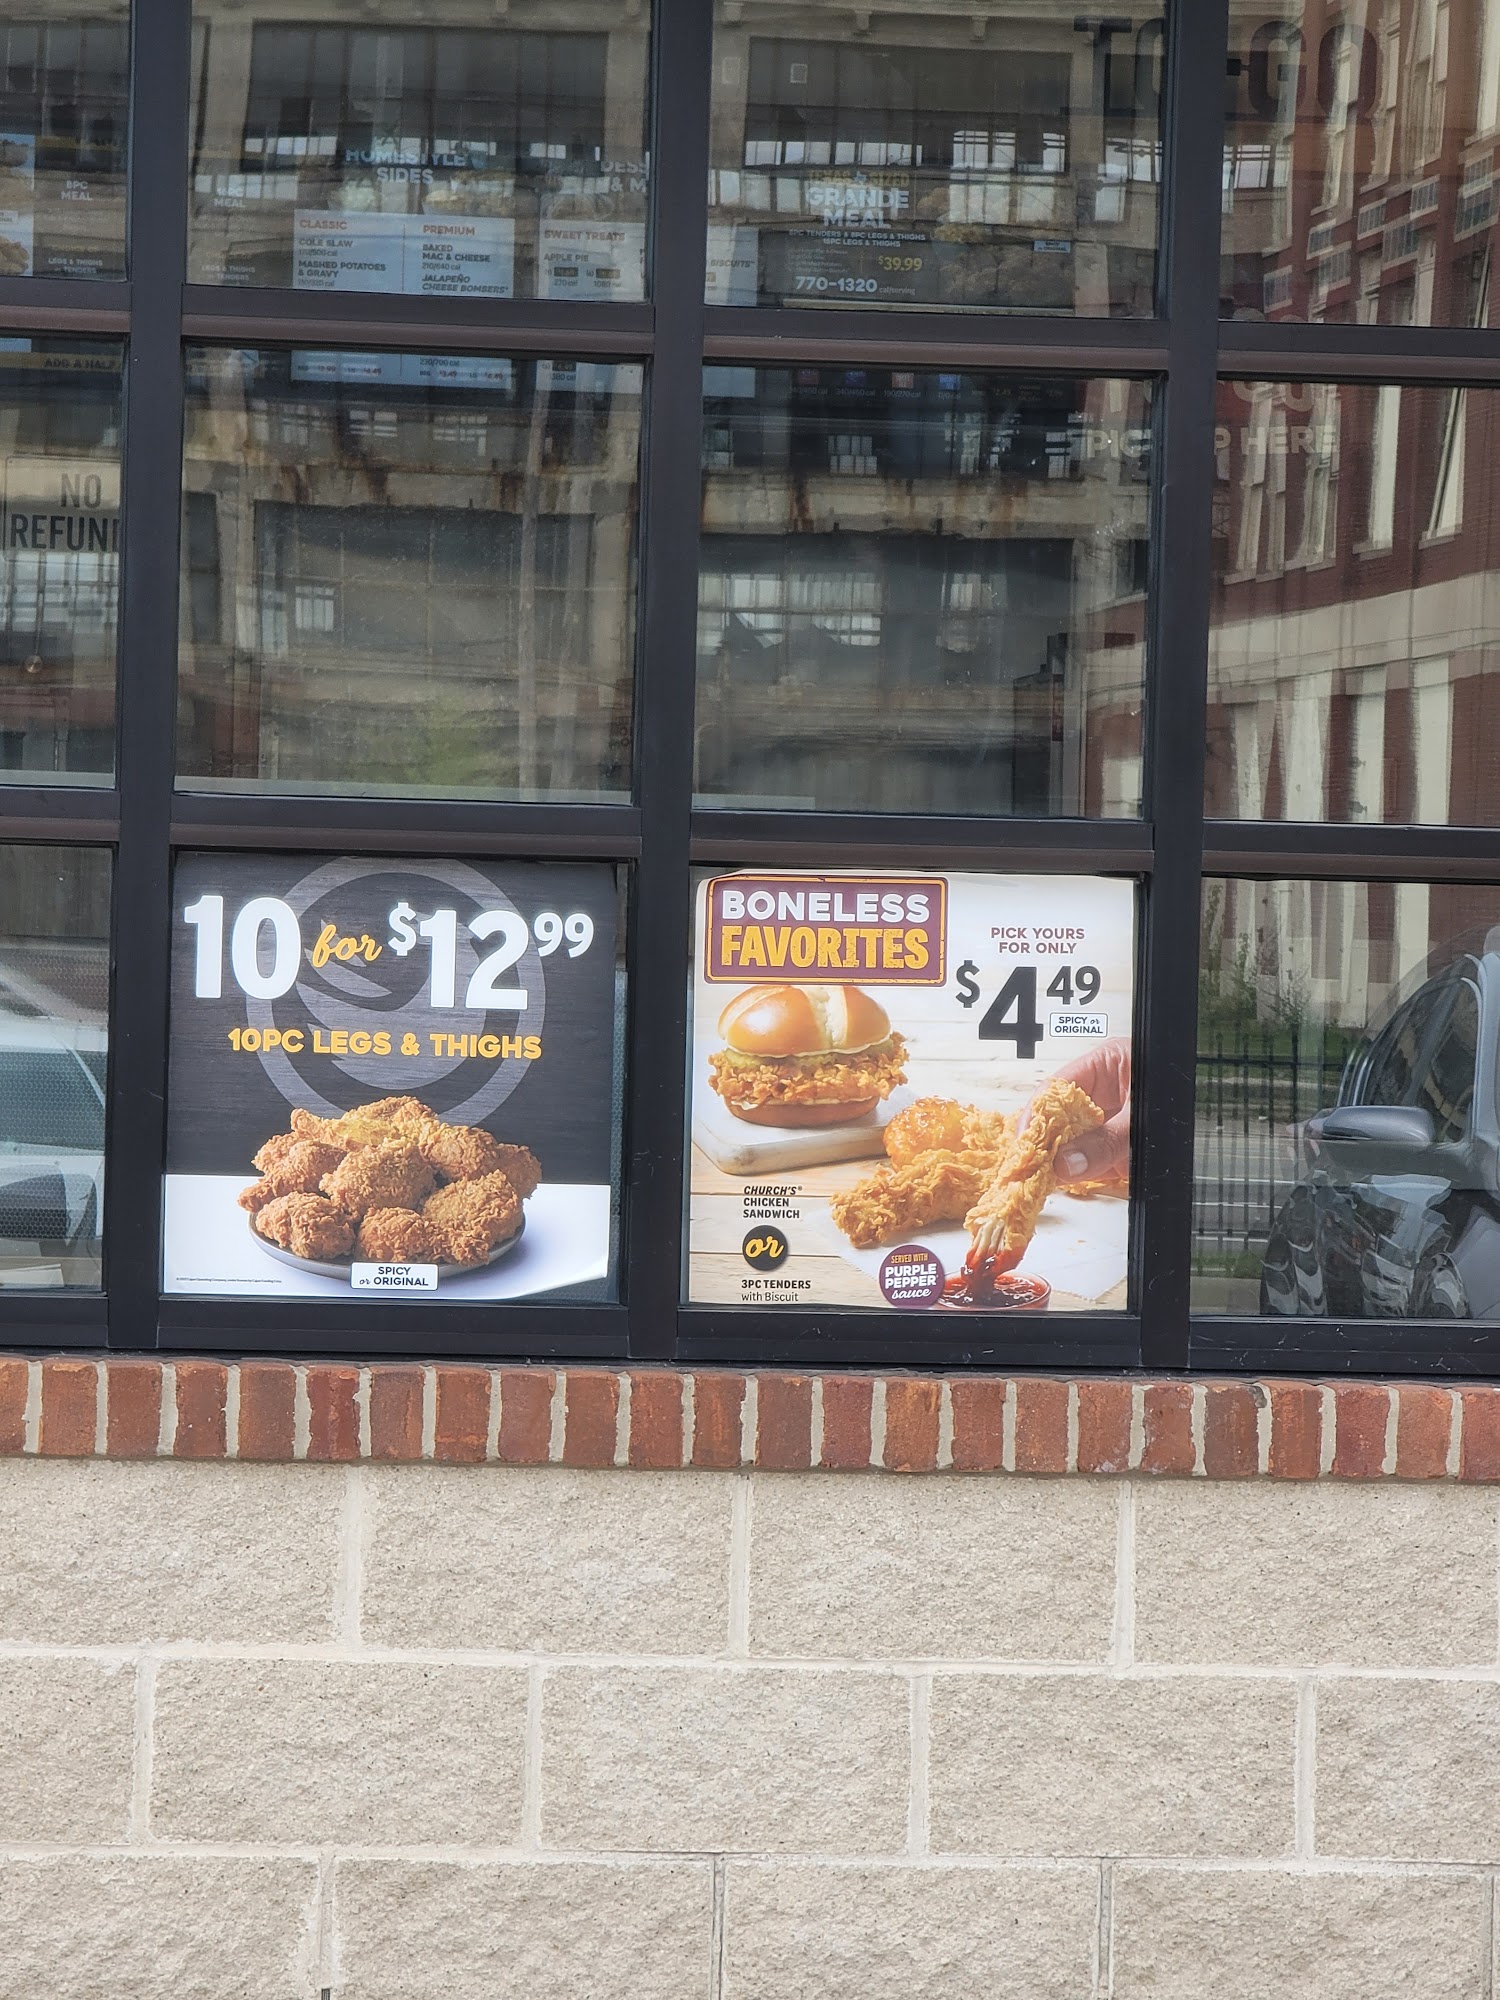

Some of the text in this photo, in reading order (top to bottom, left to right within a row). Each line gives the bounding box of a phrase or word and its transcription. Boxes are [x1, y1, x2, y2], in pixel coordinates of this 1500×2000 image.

[376, 167, 434, 185] SIDES
[61, 191, 93, 201] MEAL
[807, 187, 910, 209] GRANDE
[213, 198, 246, 208] MEAL
[824, 208, 892, 229] MEAL
[299, 219, 348, 231] CLASSIC
[423, 225, 476, 236] PREMIUM
[544, 229, 626, 242] SWEET TREATS
[806, 230, 841, 238] TENDERS
[897, 233, 926, 241] THIGHS
[299, 239, 354, 249] COLE SLAW
[422, 244, 453, 252] BAKED
[872, 240, 901, 248] THIGHS
[422, 253, 443, 261] MAC
[454, 254, 491, 263] CHEESE
[544, 253, 589, 262] APPLE PIE
[879, 255, 923, 272] $39.99
[298, 260, 386, 272] MASHED POTATOES
[307, 270, 339, 278] GRAVY
[422, 273, 471, 284] JALAPEÑO
[422, 283, 458, 292] CHEESE
[795, 276, 878, 293] 770-1320
[1086, 429, 1150, 459] PIC
[1240, 425, 1341, 456] HERE
[60, 473, 102, 509] NO
[721, 889, 931, 924] BONELESS
[991, 926, 1085, 940] PICK YOURS
[184, 894, 302, 1000] 10
[312, 923, 384, 969] for
[720, 924, 931, 970] FAVORITES
[999, 942, 1078, 954] FOR ONLY
[1058, 1016, 1088, 1025] SPICY
[1054, 1025, 1103, 1034] ORIGINAL
[228, 1027, 543, 1060] 10PC LEGS & THIGHS
[743, 1197, 790, 1207] CHICKEN
[742, 1209, 800, 1219] SANDWICH
[745, 1235, 784, 1258] or
[890, 1252, 929, 1264] SERVED WITH
[378, 1266, 412, 1276] SPICY
[885, 1263, 937, 1278] PURPLE
[359, 1276, 429, 1287] or ORIGINAL
[741, 1279, 812, 1290] 3PC TENDERS
[884, 1275, 937, 1290] PEPPER
[741, 1291, 799, 1302] with Biscuit
[891, 1288, 932, 1300] sauce
